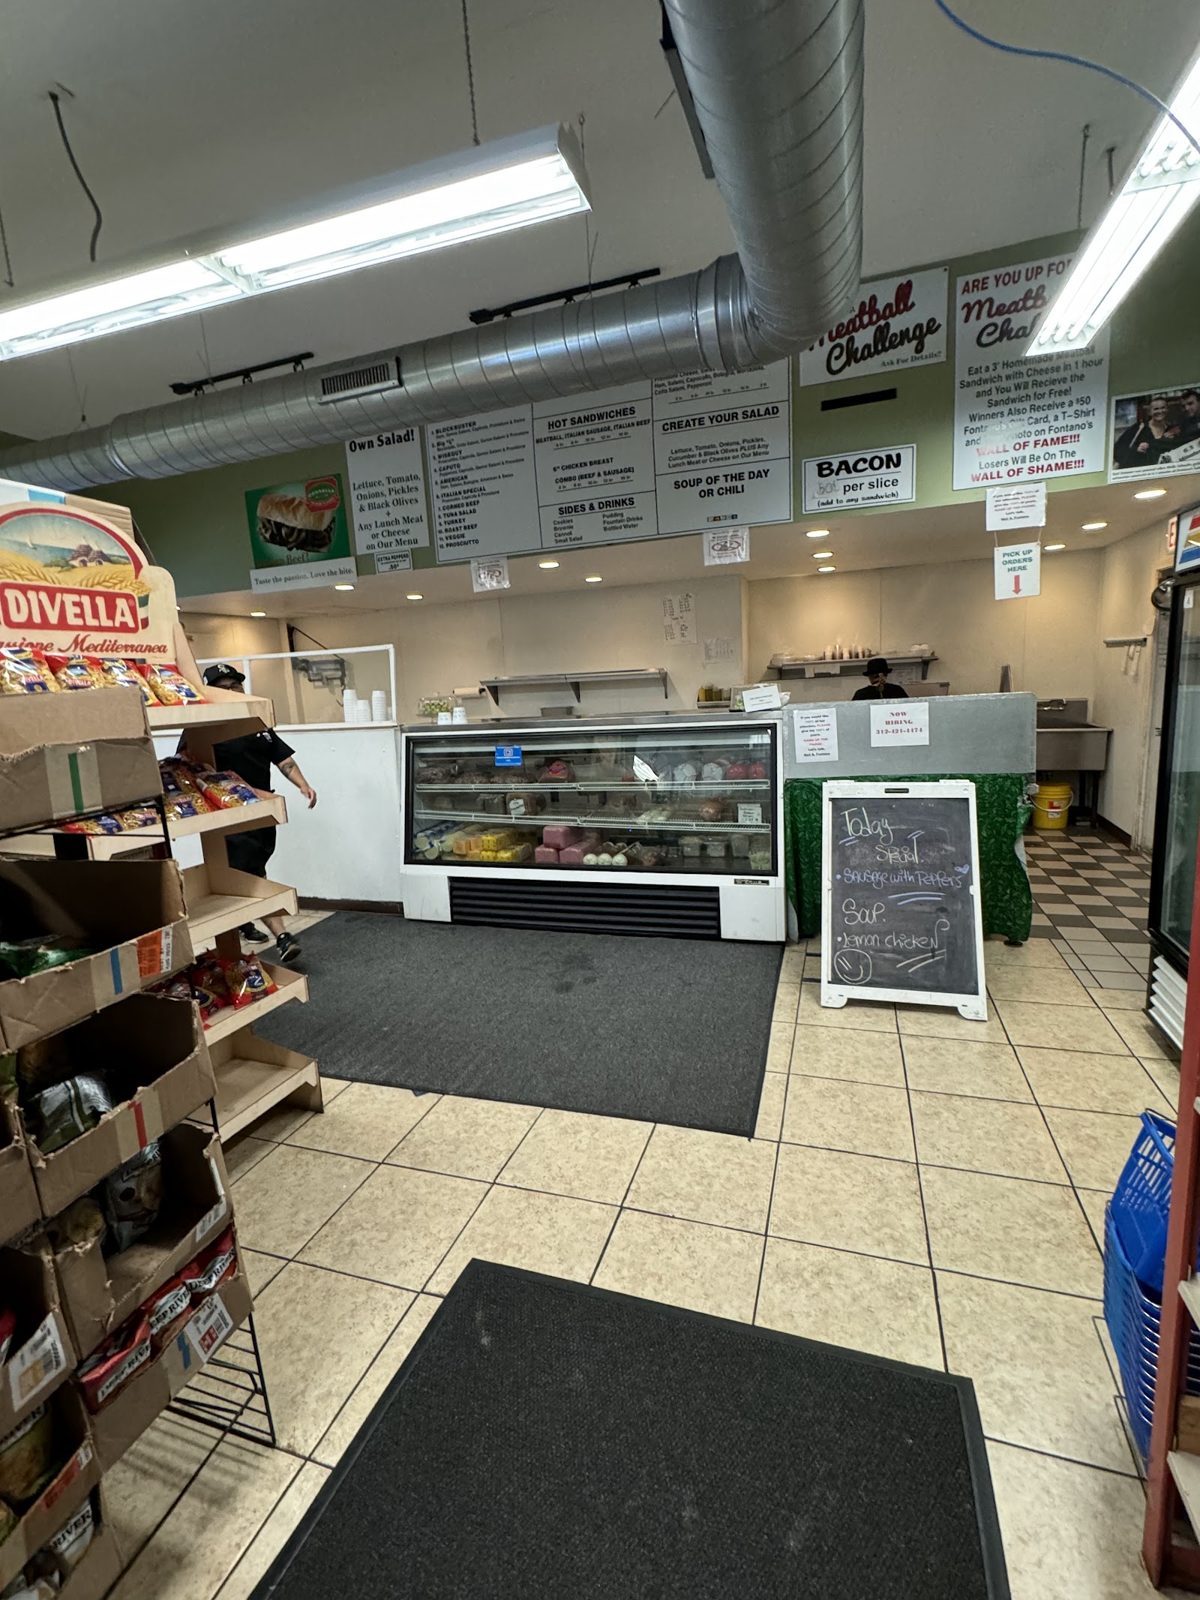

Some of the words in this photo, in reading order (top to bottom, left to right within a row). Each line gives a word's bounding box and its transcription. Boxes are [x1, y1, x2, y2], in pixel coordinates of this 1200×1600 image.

[961, 276, 990, 295] ARE
[994, 269, 1022, 288] YOU
[1025, 265, 1043, 282] UP
[826, 317, 942, 375] Challenge
[959, 375, 1003, 389] Sandwich
[1005, 372, 1024, 381] with
[1026, 363, 1061, 377] Cheese
[1063, 361, 1072, 370] in
[1075, 361, 1079, 369] 1
[1082, 358, 1104, 368] hour
[967, 366, 984, 376] Eat
[1002, 356, 1053, 370] Homemade
[976, 389, 992, 398] and
[995, 386, 1011, 395] You
[1014, 381, 1029, 391] Will
[1031, 375, 1068, 389] Recieve
[1070, 373, 1085, 382] the
[987, 393, 1031, 408] Sandwich
[1033, 391, 1046, 400] for
[1049, 386, 1072, 397] Free!
[547, 419, 568, 430] HOT
[570, 406, 636, 425] SANDWICHES
[662, 416, 705, 432] CREATE
[708, 411, 739, 425] YOUR
[741, 405, 779, 420] SALAD
[969, 410, 1005, 423] Winners
[1007, 406, 1027, 416] Also
[1029, 400, 1066, 414] Receive
[1027, 415, 1051, 426] Card,
[1062, 408, 1096, 421] T-Shirt
[1034, 429, 1045, 437] on
[1048, 420, 1093, 435] Fontano's
[349, 440, 374, 452] Own
[377, 428, 415, 448] Salad!
[1013, 440, 1030, 451] OF
[1033, 434, 1081, 449] FAME!!!
[816, 452, 902, 478] BACON
[979, 459, 1009, 470] Losers
[1011, 455, 1027, 465] Will
[1029, 454, 1041, 463] Be
[1043, 452, 1057, 461] On
[1059, 449, 1077, 459] The
[673, 478, 703, 490] SOUP
[705, 475, 720, 485] OF
[723, 472, 745, 483] THE
[748, 469, 770, 480] DAY
[971, 470, 1004, 482] WALL
[1007, 467, 1024, 478] OF
[1027, 459, 1085, 475] SHAME!!!
[353, 479, 385, 491] Lettuce,
[386, 474, 421, 485] Tomato,
[356, 489, 387, 501] Onions,
[388, 484, 419, 496] Pickles
[698, 488, 714, 498] OR
[717, 485, 745, 496] CHILI
[843, 481, 865, 495] per
[867, 478, 899, 489] slice
[359, 504, 366, 513] &
[367, 499, 391, 512] Black
[392, 496, 419, 508] Olives
[558, 504, 586, 515] SIDES
[588, 503, 595, 511] &
[598, 497, 635, 510] DRINKS
[357, 521, 373, 532] Any
[375, 517, 400, 529] Lunch
[402, 514, 424, 525] Meat
[371, 532, 380, 540] or
[381, 527, 410, 538] Cheese
[377, 539, 394, 549] Our
[395, 536, 419, 547] Menu
[1002, 557, 1033, 566] ORDERS
[1007, 565, 1028, 573] HERE
[310, 570, 327, 578] Love
[327, 568, 339, 577] the
[4, 588, 136, 629] DIVELLA
[57, 633, 168, 654] Mediterranea
[840, 807, 894, 846] Today
[889, 869, 915, 883] with
[168, 1290, 191, 1314] RIVE
